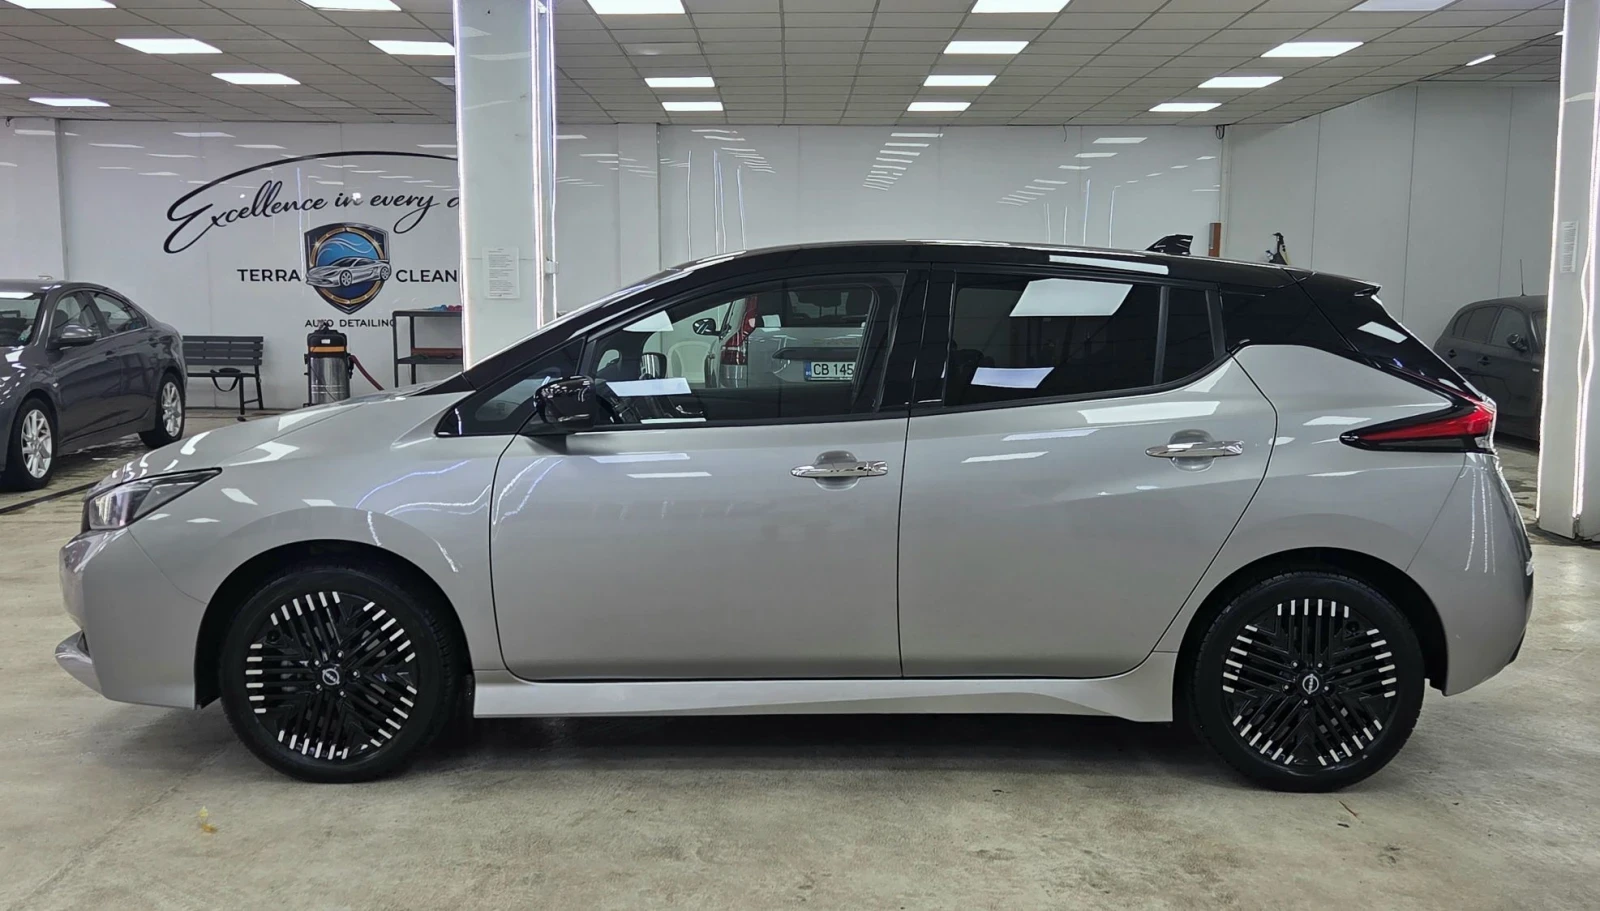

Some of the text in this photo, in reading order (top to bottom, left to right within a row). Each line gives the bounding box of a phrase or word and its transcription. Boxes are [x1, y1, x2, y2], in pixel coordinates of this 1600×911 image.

[163, 180, 441, 254] Excellence in every
[237, 269, 458, 283] TERRA CLEAN
[813, 363, 854, 376] CB 145
